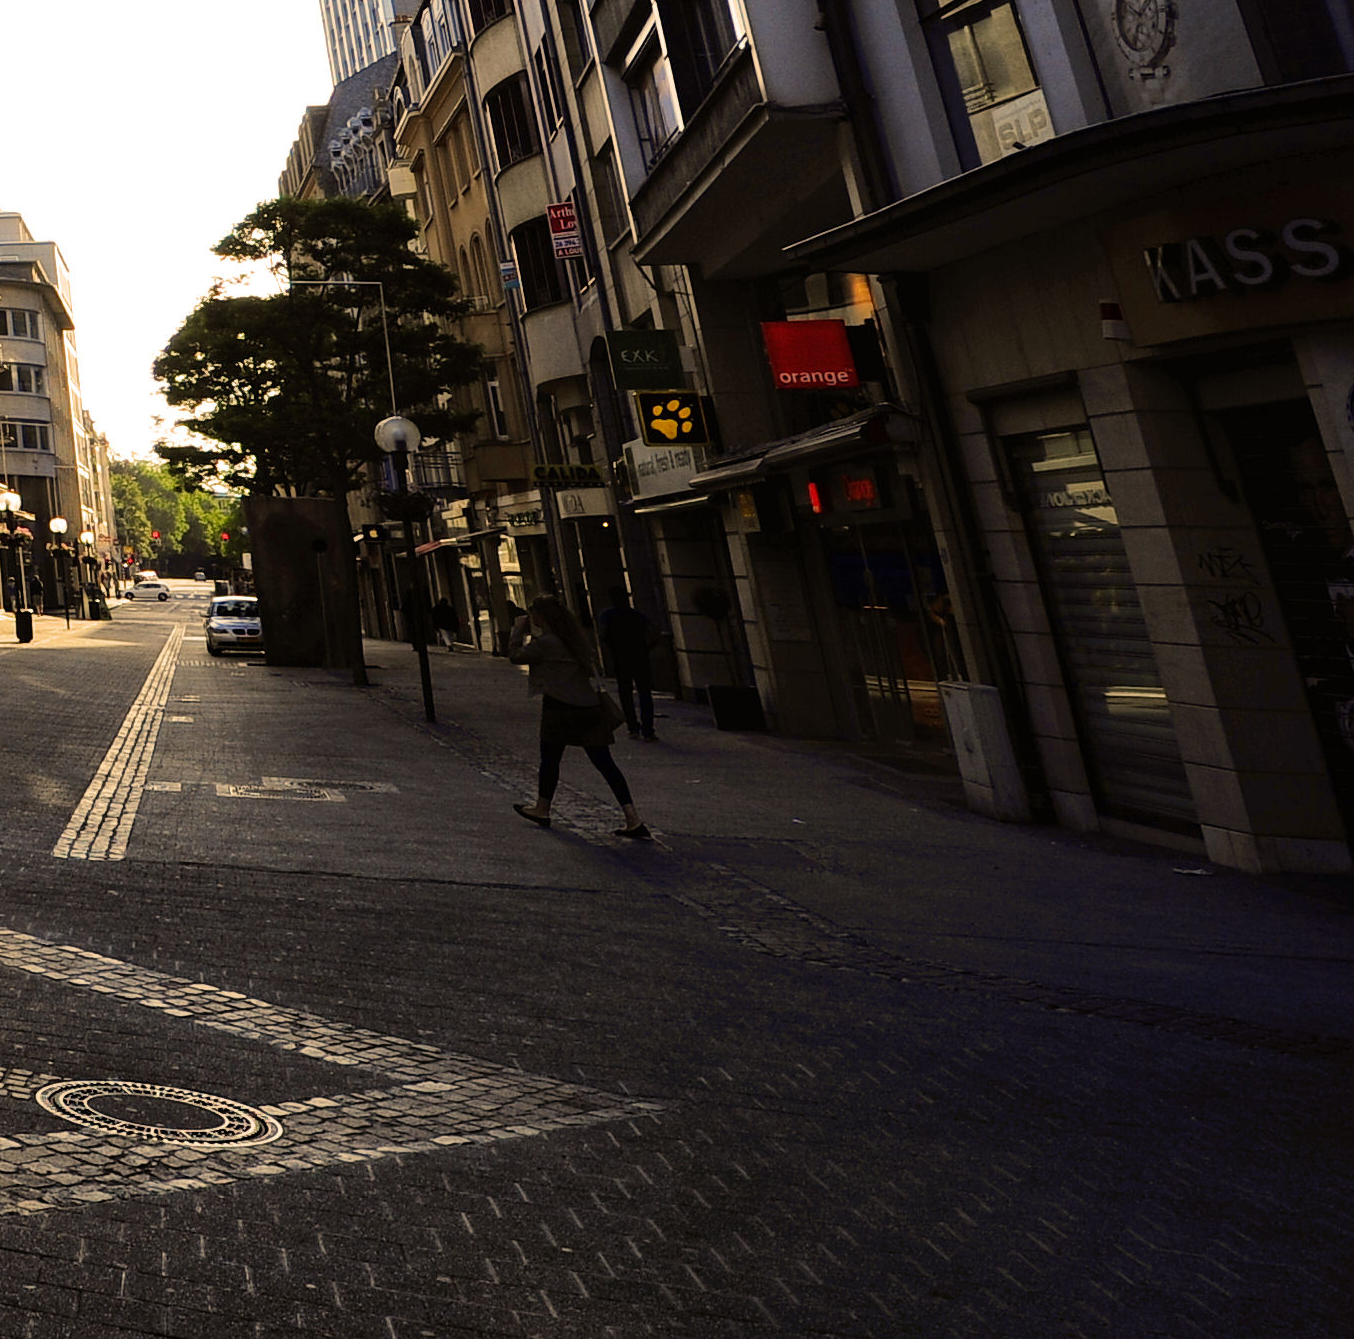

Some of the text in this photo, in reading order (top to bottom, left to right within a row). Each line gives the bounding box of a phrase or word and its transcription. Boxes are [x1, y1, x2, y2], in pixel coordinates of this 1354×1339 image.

[1142, 217, 1341, 304] KASS
[779, 370, 850, 387] orange
[534, 466, 601, 480] CALIDA
